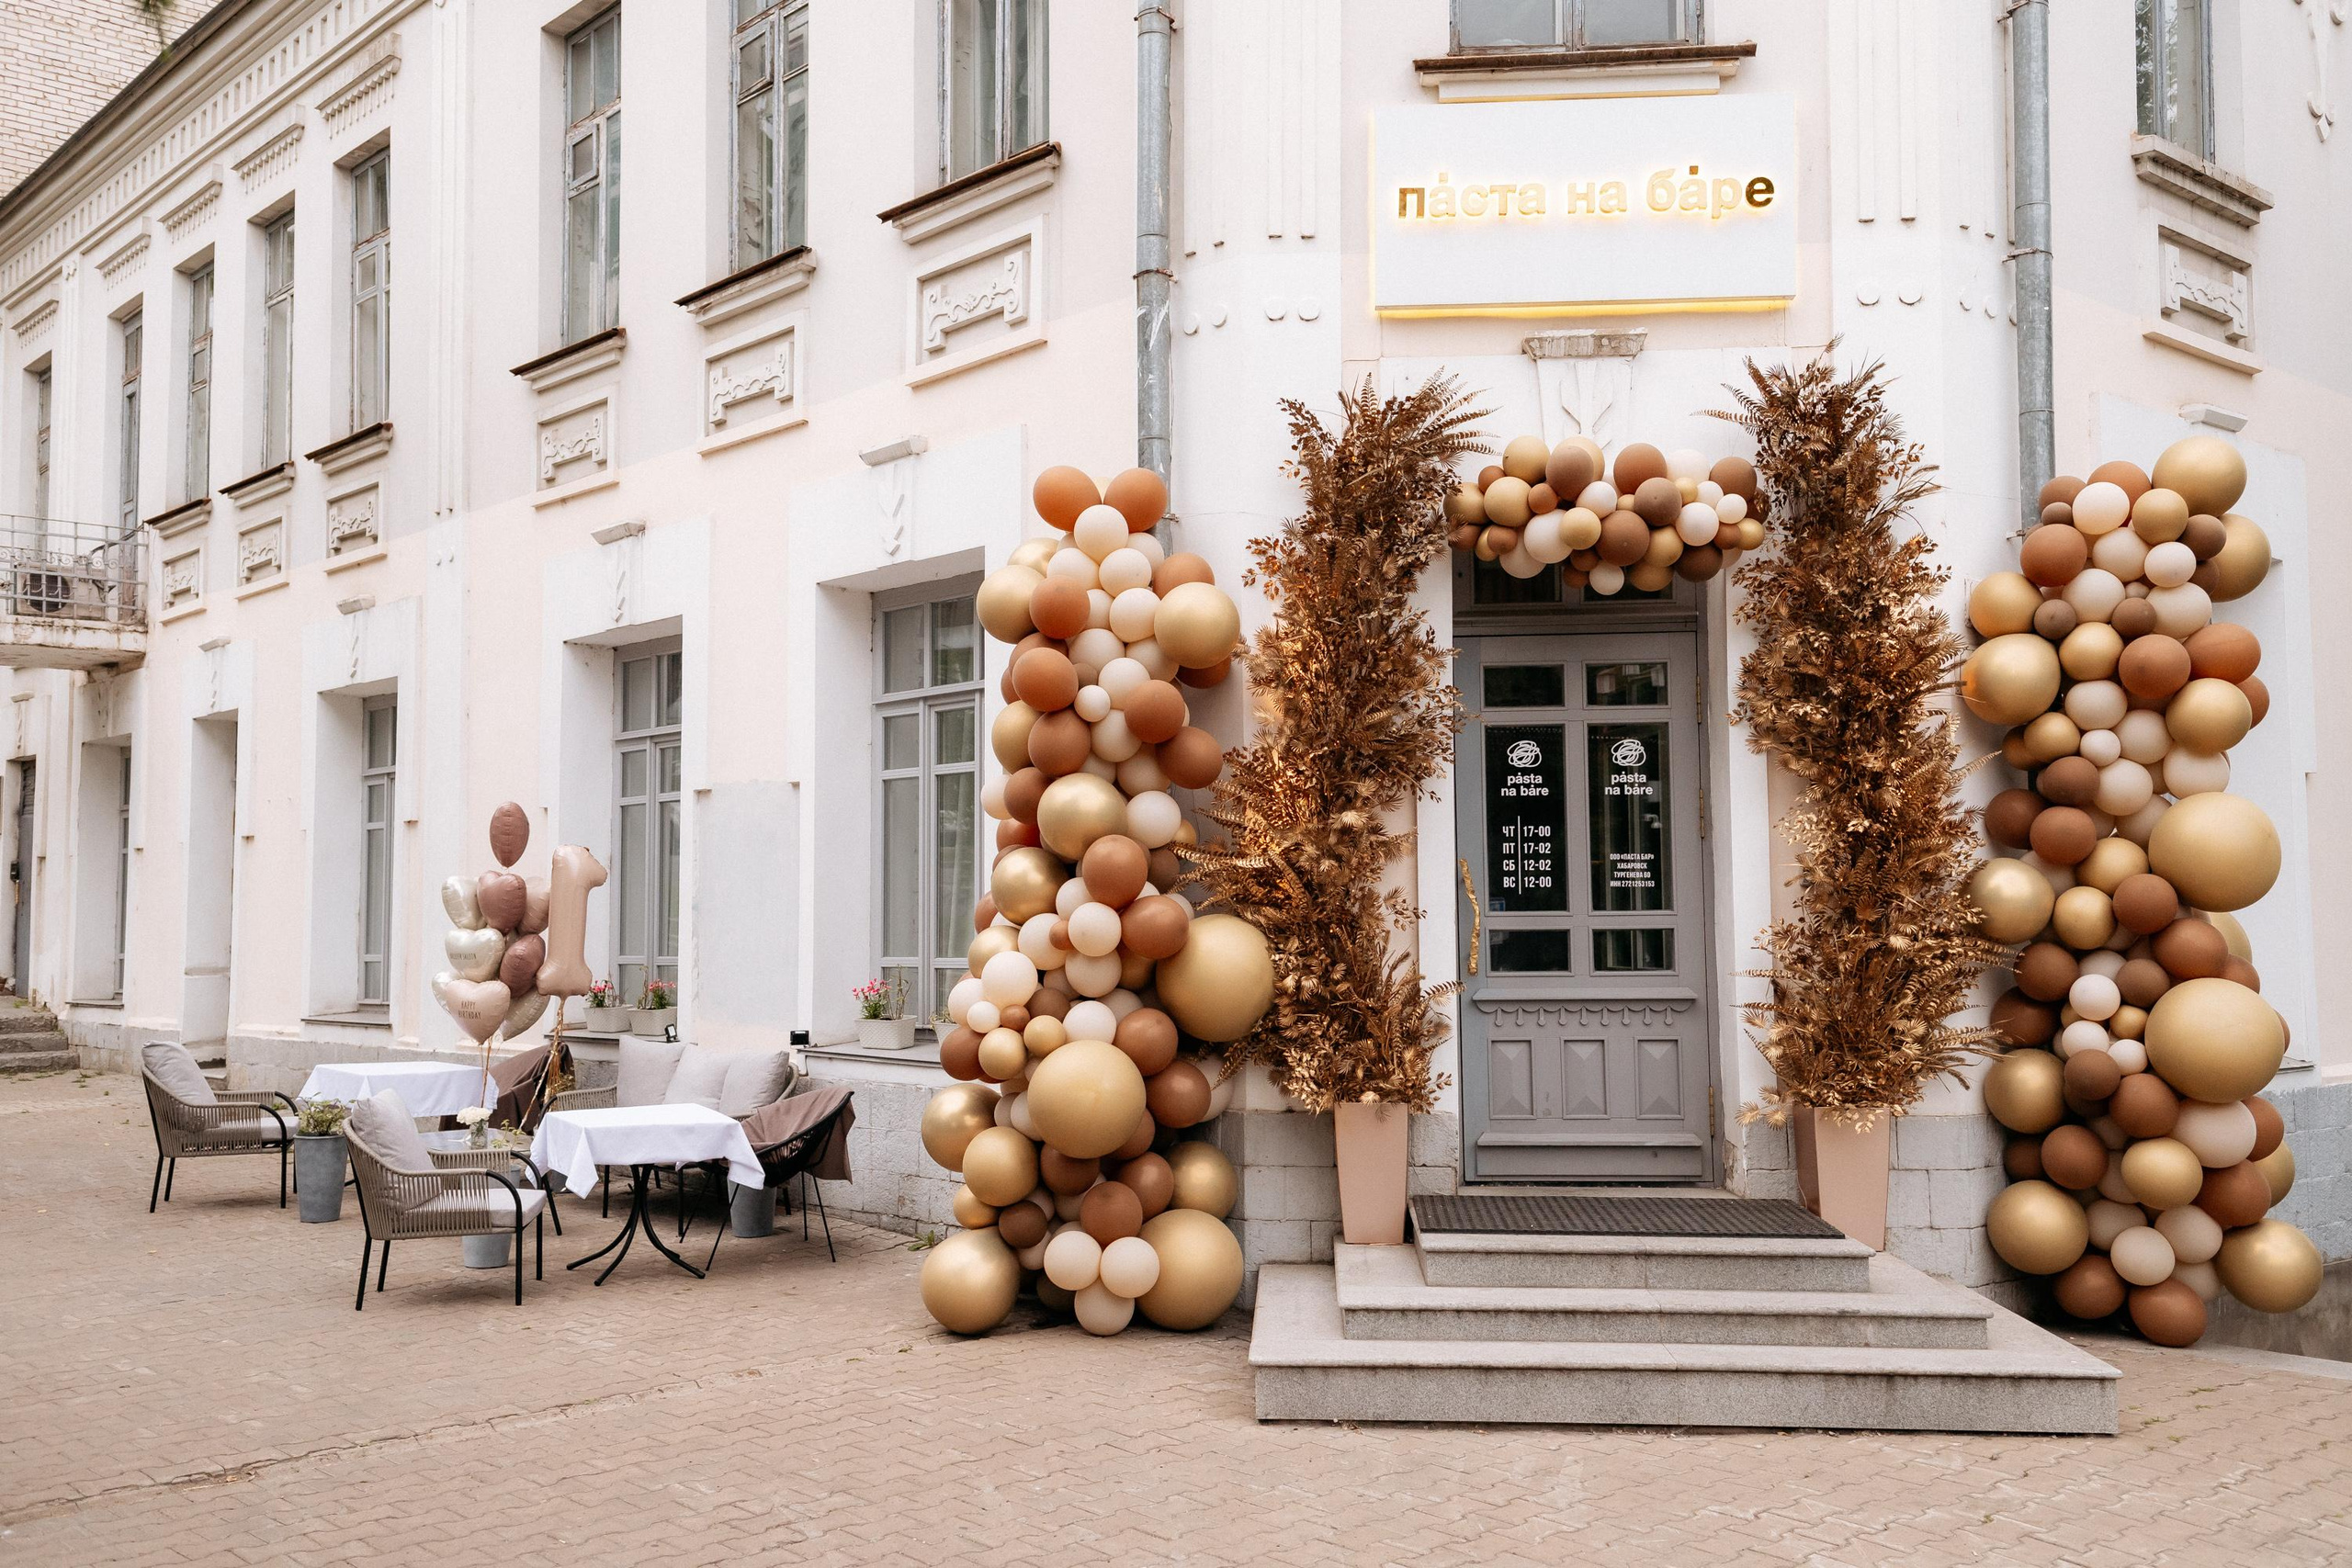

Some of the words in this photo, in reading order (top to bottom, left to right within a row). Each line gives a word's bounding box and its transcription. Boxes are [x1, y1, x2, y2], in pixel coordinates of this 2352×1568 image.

[1567, 181, 1628, 214] на
[1501, 787, 1517, 796] na
[1604, 786, 1621, 795] na
[1502, 826, 1516, 837] ЧТ
[1523, 826, 1552, 837] 17-00
[1502, 843, 1516, 854] ПТ
[1523, 843, 1552, 854] 17-02
[1502, 860, 1516, 871] СБ
[1523, 860, 1552, 871] 12-02
[1616, 862, 1647, 870] ХАБАРОВСК
[1502, 876, 1516, 888] ВС
[1523, 876, 1552, 888] 12-00
[461, 1000, 476, 1010] HAPPY
